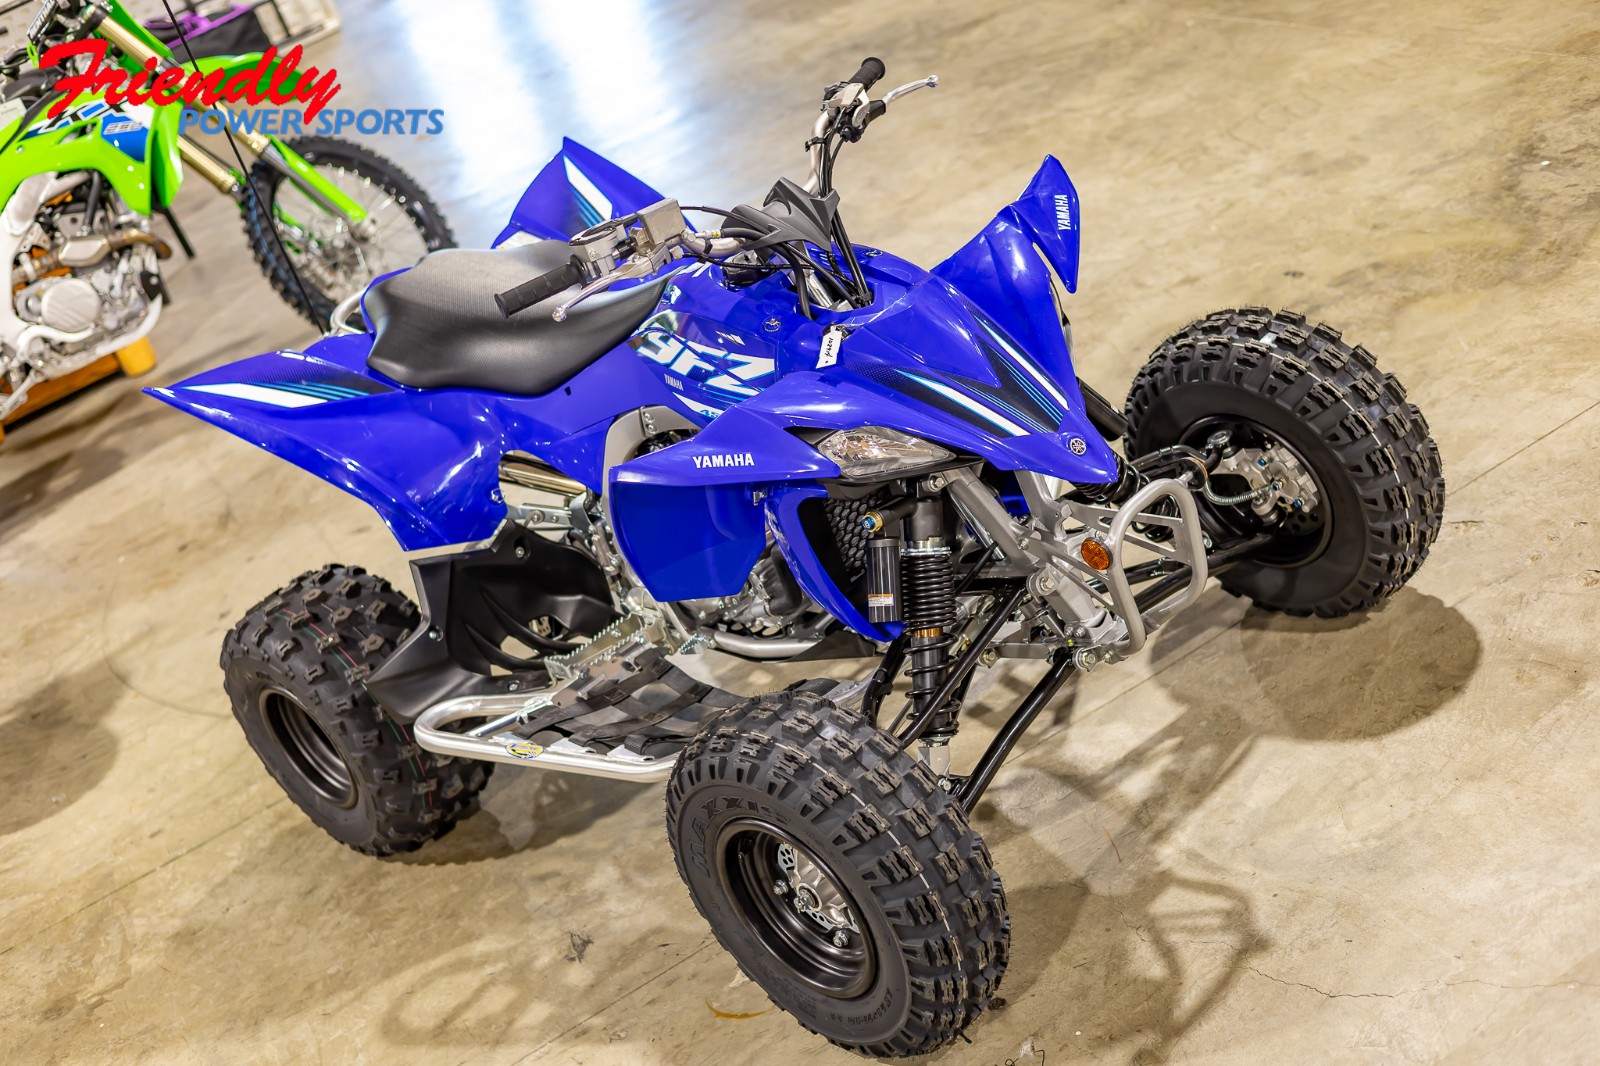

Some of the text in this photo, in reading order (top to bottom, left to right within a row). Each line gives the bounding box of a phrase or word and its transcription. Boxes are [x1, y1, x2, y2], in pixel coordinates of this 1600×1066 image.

[1054, 195, 1071, 230] YAMAHA
[664, 373, 684, 391] YAMAHA
[693, 453, 755, 468] YAMAHA
[689, 797, 788, 878] MAXXIS
